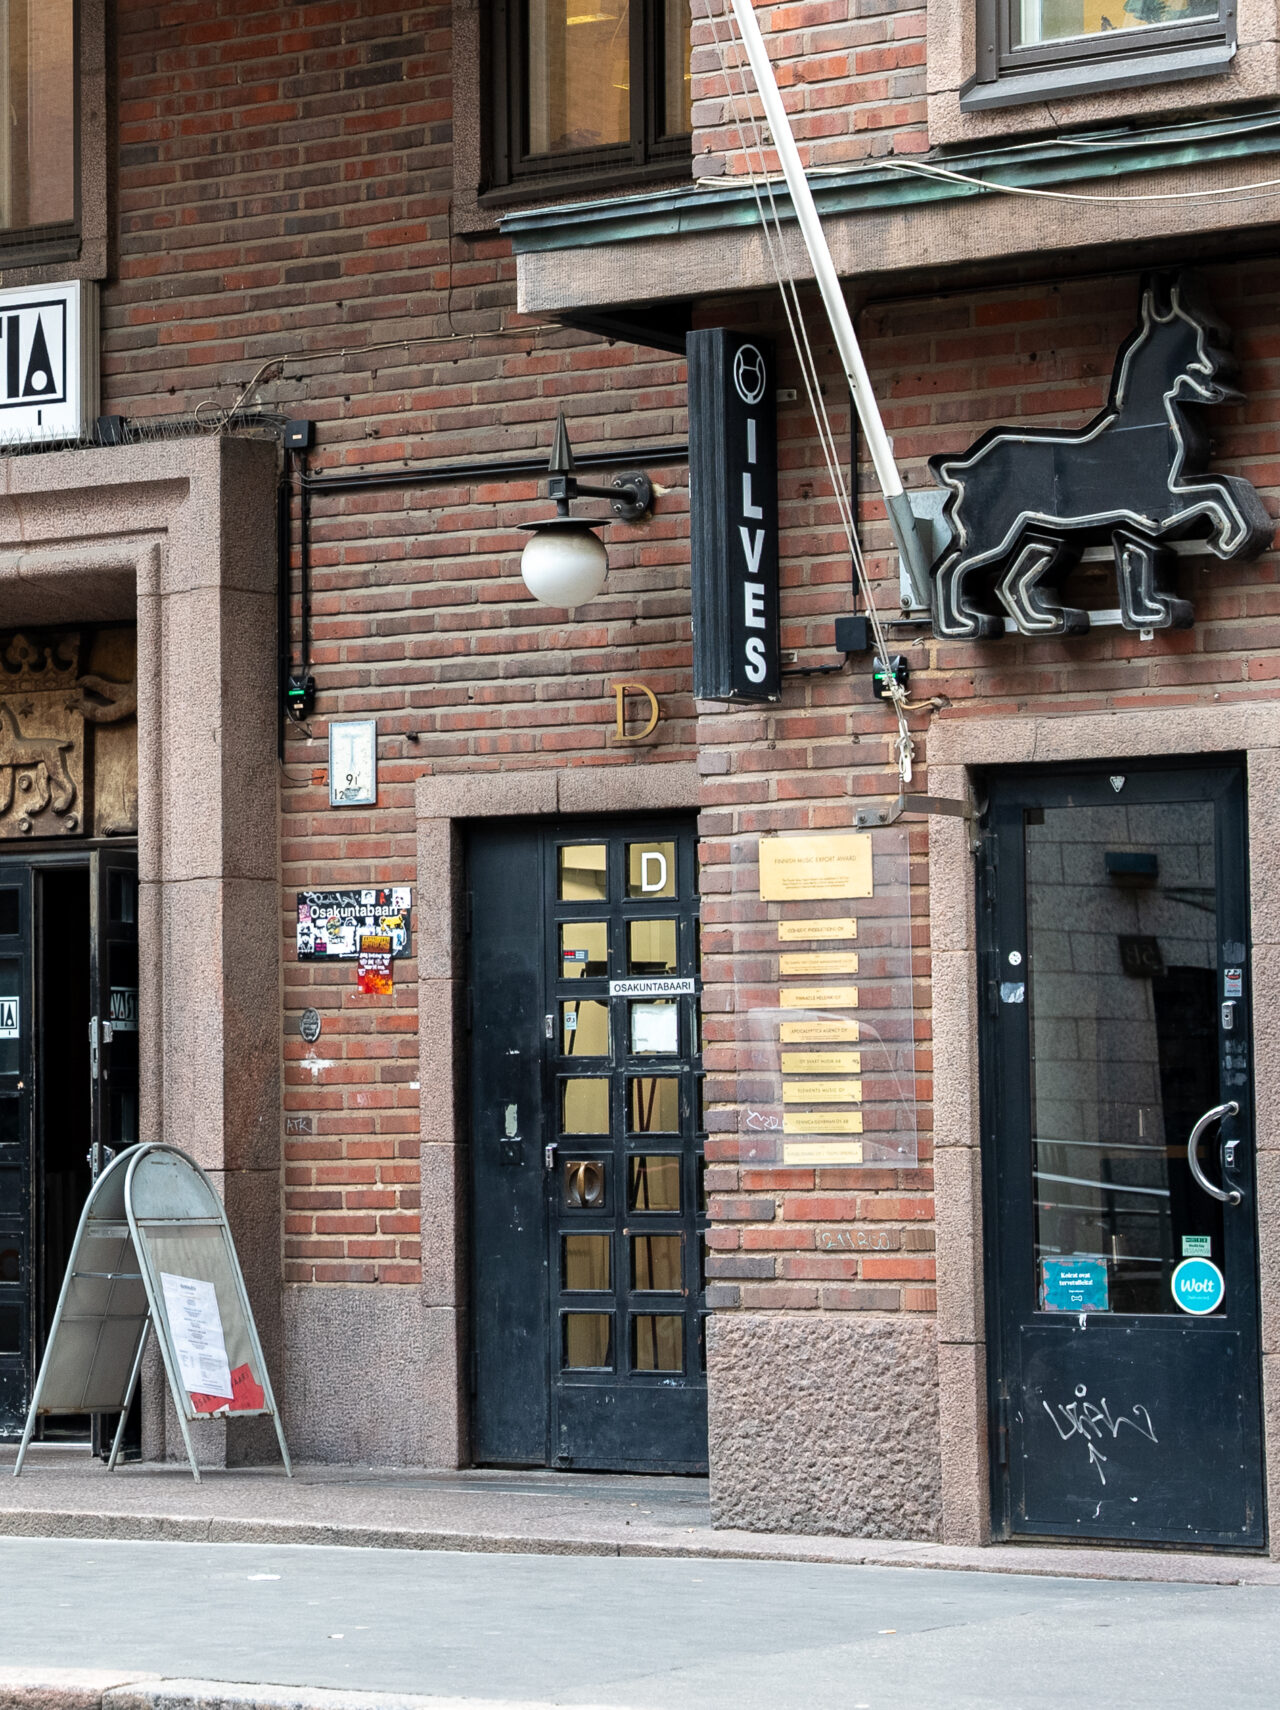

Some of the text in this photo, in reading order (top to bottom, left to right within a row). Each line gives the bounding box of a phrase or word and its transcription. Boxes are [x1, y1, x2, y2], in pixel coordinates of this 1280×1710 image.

[738, 418, 767, 684] ILVES
[611, 683, 660, 741] D
[641, 851, 667, 893] D
[614, 981, 691, 993] OSAKUNTABAARI
[1181, 1278, 1214, 1292] Wolt
